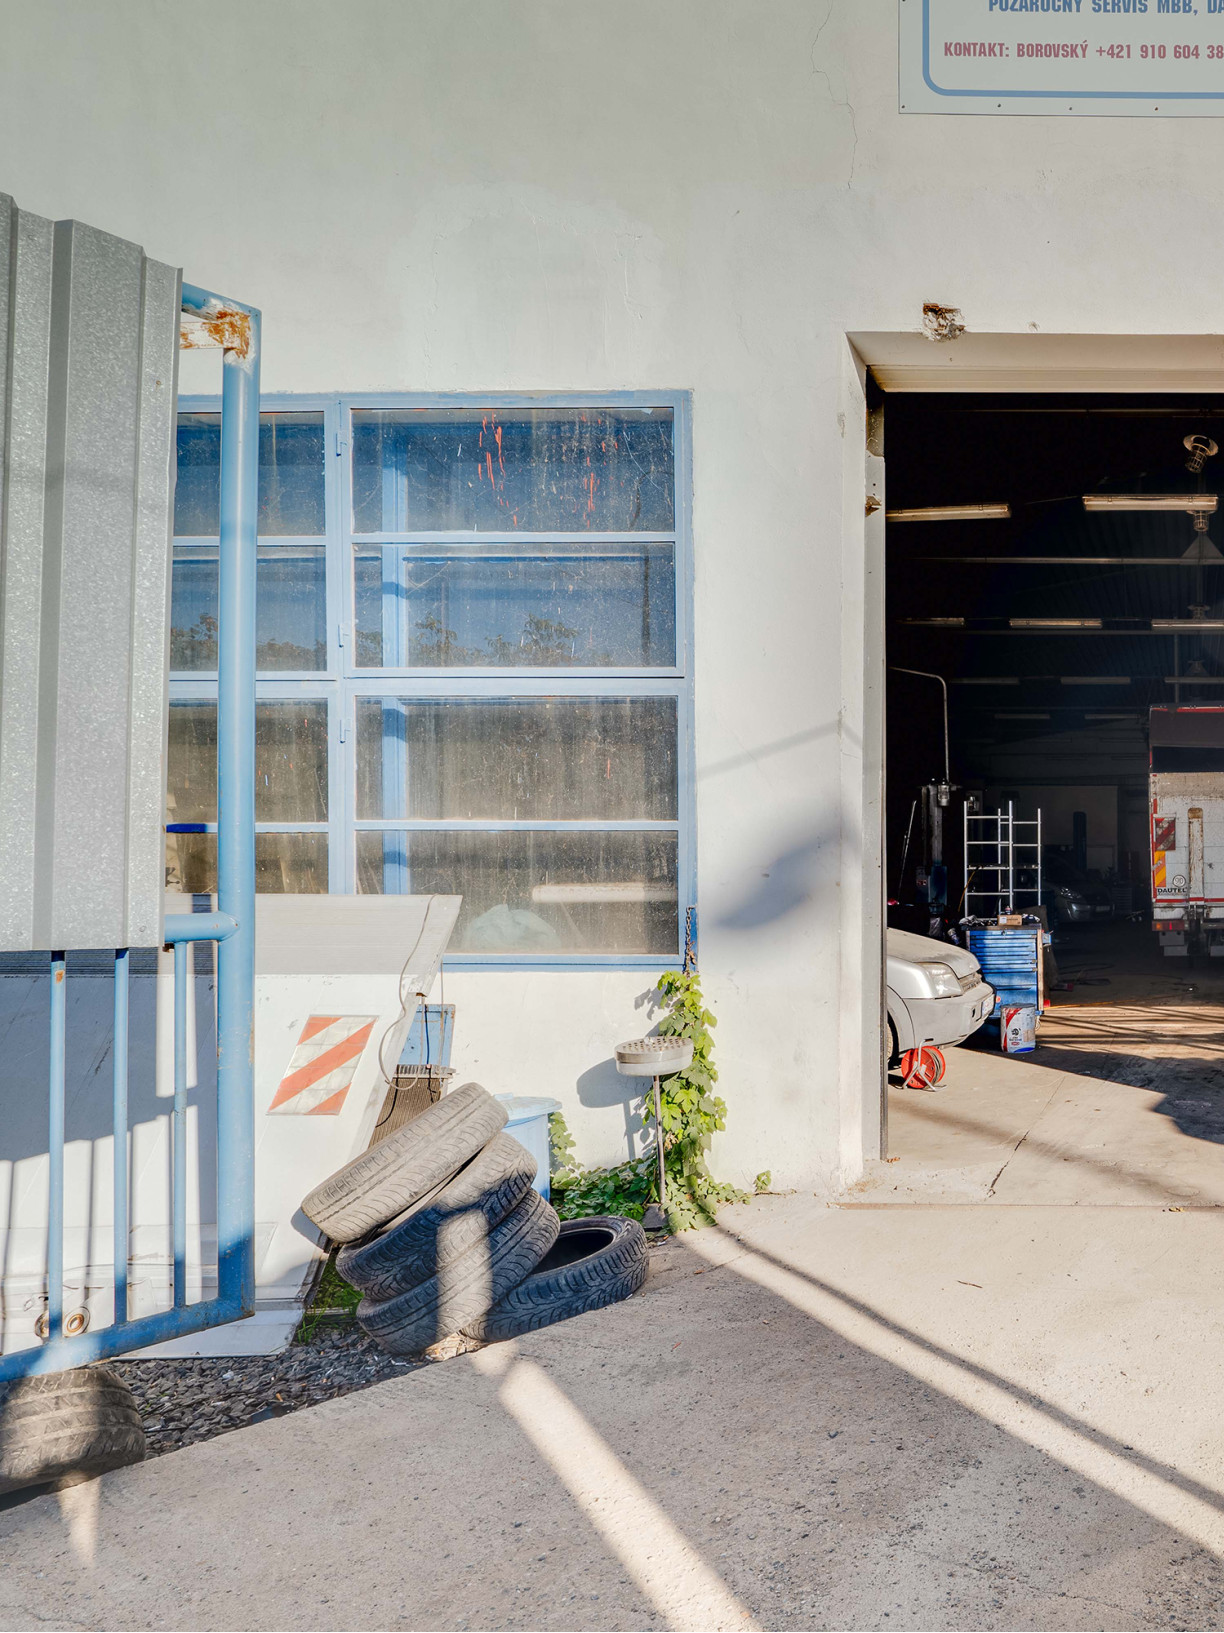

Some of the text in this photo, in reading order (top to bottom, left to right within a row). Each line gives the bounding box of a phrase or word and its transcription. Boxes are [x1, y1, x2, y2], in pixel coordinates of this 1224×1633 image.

[1092, 0, 1148, 13] SERVIS
[1157, 0, 1198, 16] MBB,
[943, 41, 1010, 58] KONTAKT:
[1016, 40, 1089, 58] BOROVSKÝ
[1095, 43, 1132, 59] +421
[1140, 44, 1167, 59] 910
[1173, 44, 1200, 60] 604
